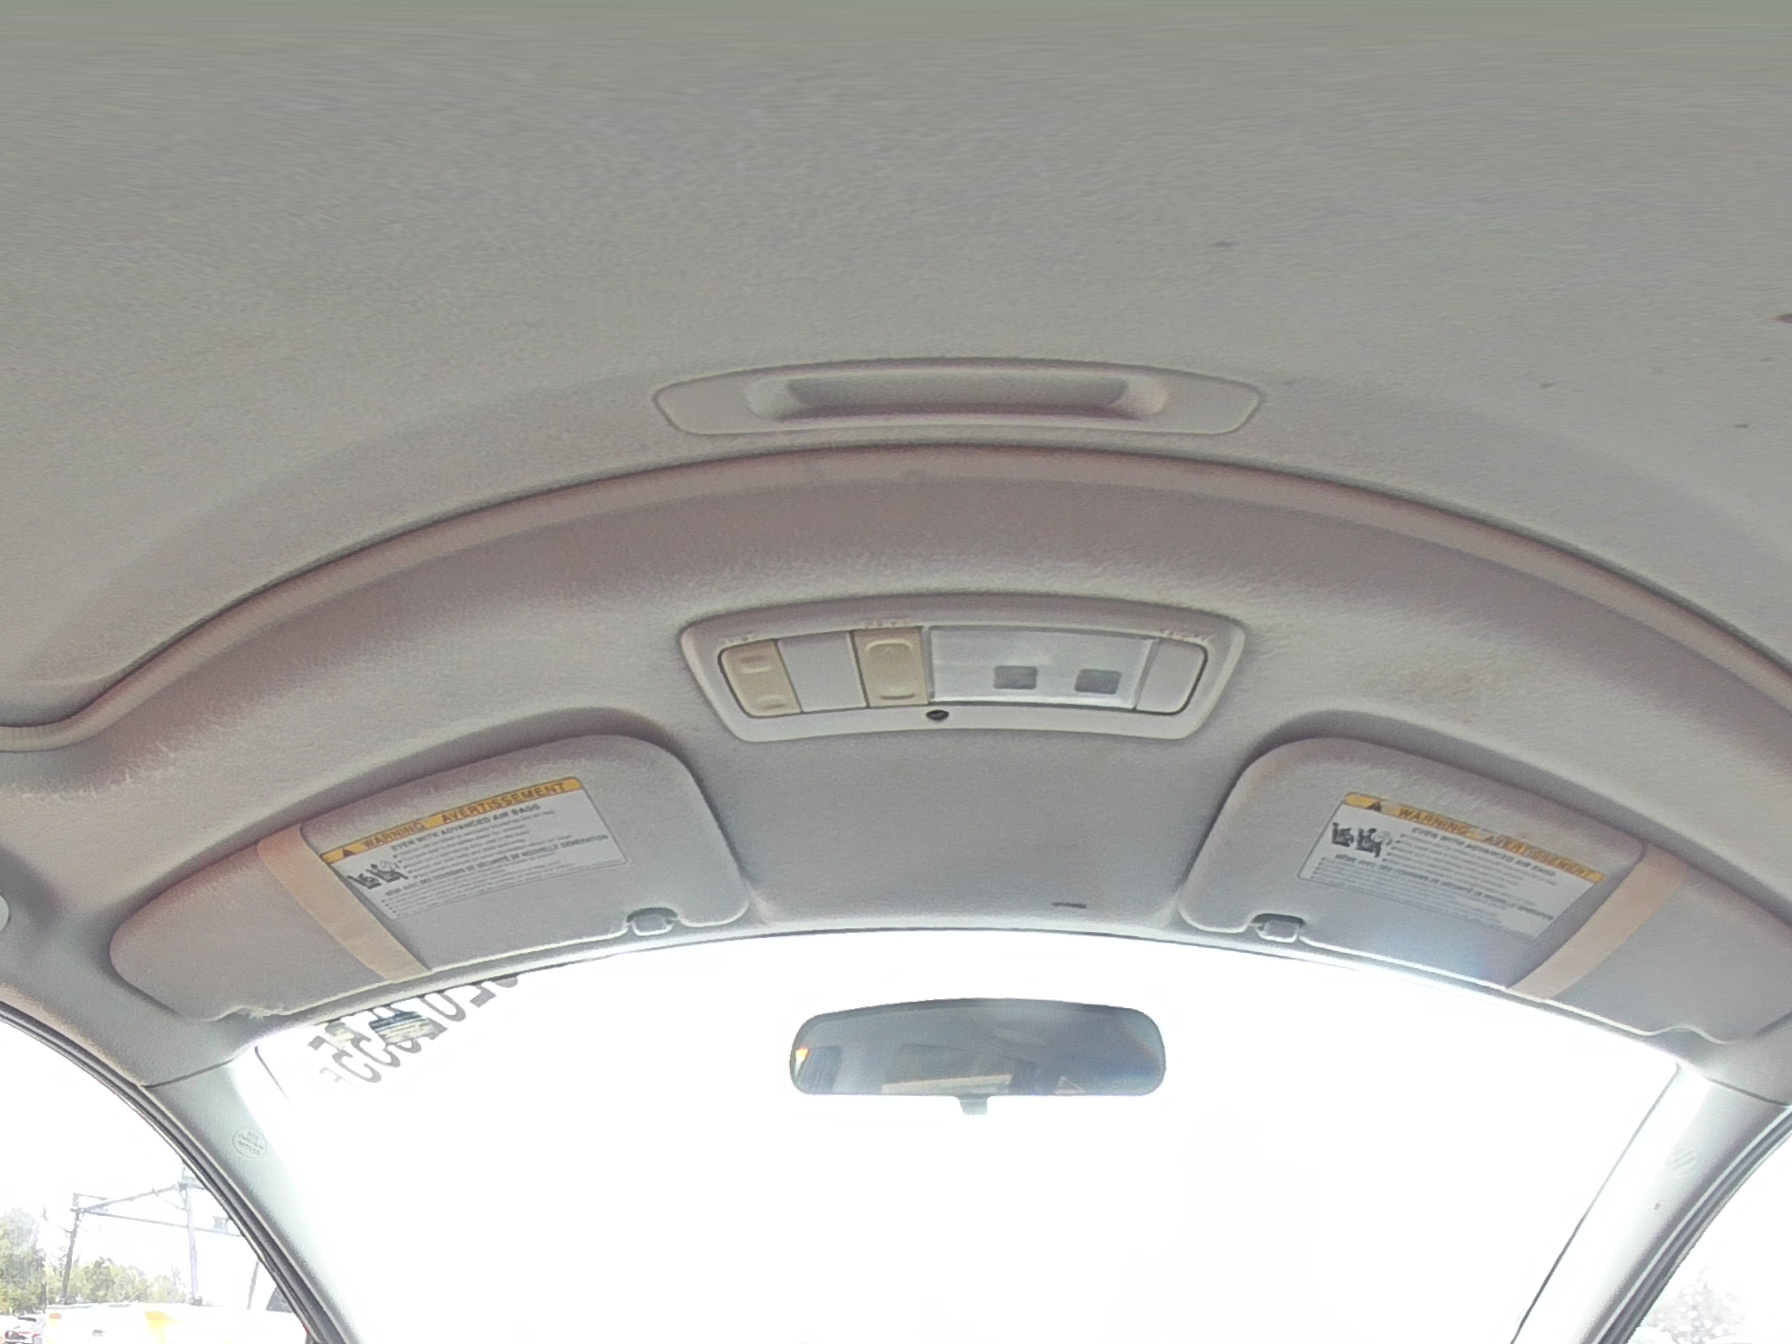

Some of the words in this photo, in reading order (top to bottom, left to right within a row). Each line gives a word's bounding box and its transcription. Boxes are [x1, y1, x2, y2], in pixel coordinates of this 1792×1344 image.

[361, 822, 426, 849] WARNING
[442, 782, 566, 824] AVERTISSEMENT
[391, 838, 415, 852] EVEN
[441, 816, 491, 836] ADVANCED
[511, 803, 541, 817] BAGS
[1398, 806, 1468, 835] WARNING
